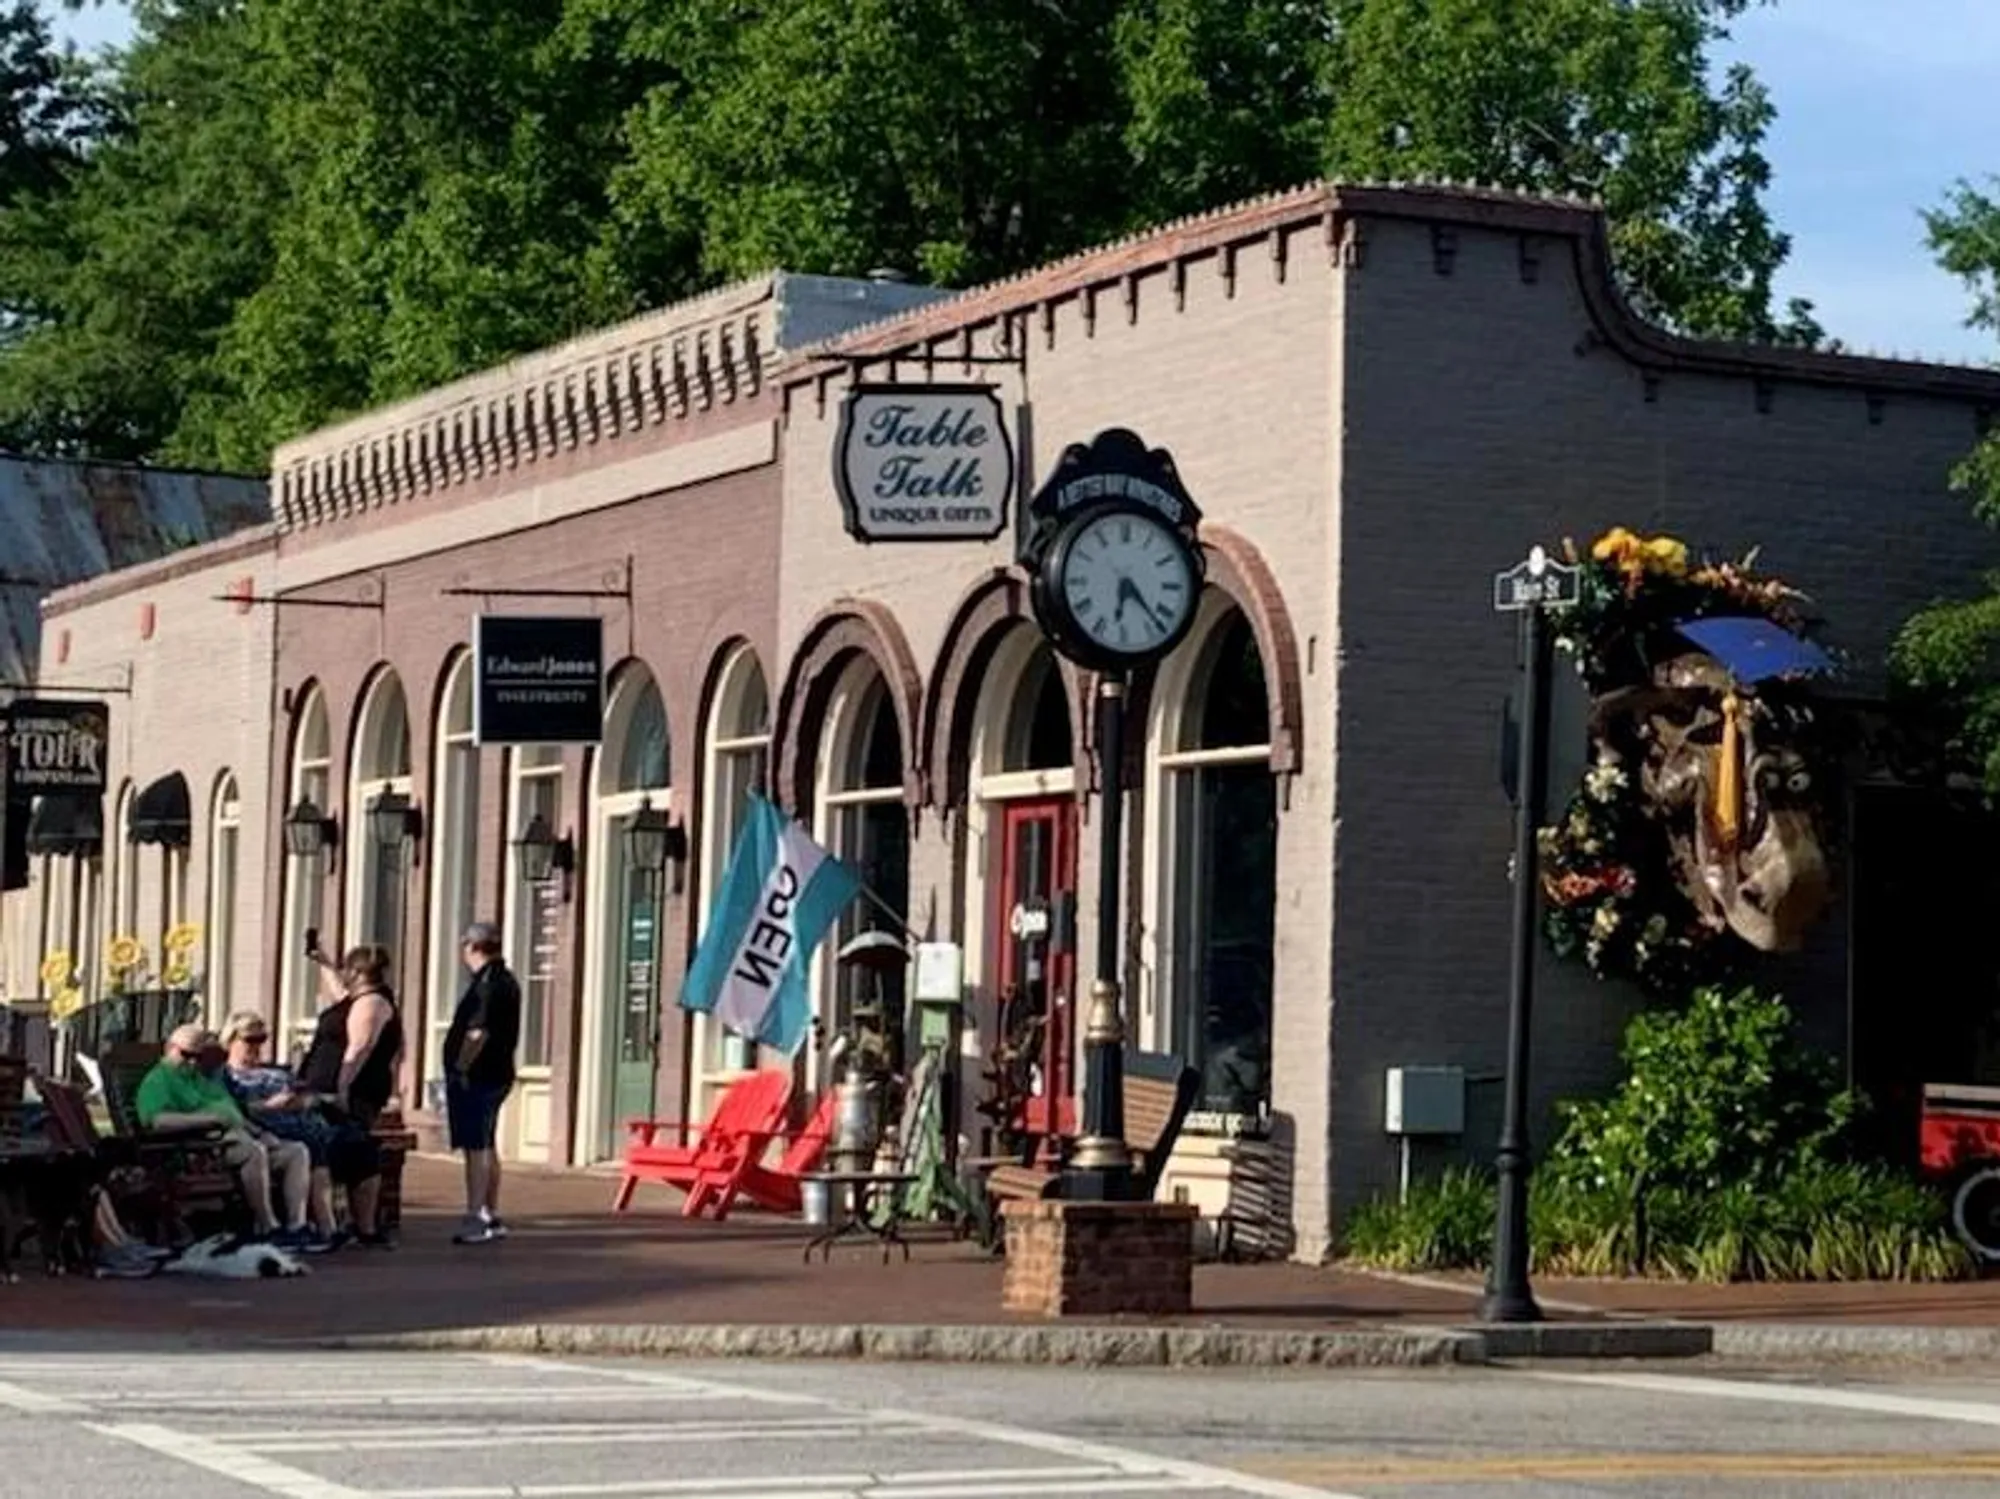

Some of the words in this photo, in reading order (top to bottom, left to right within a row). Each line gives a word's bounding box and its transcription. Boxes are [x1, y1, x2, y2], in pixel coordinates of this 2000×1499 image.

[864, 404, 988, 447] Table
[874, 455, 983, 498] Talk
[869, 506, 939, 524] UNIQUE
[944, 506, 992, 521] GIFTS
[10, 729, 100, 773] TOUR
[1010, 901, 1047, 940] Open
